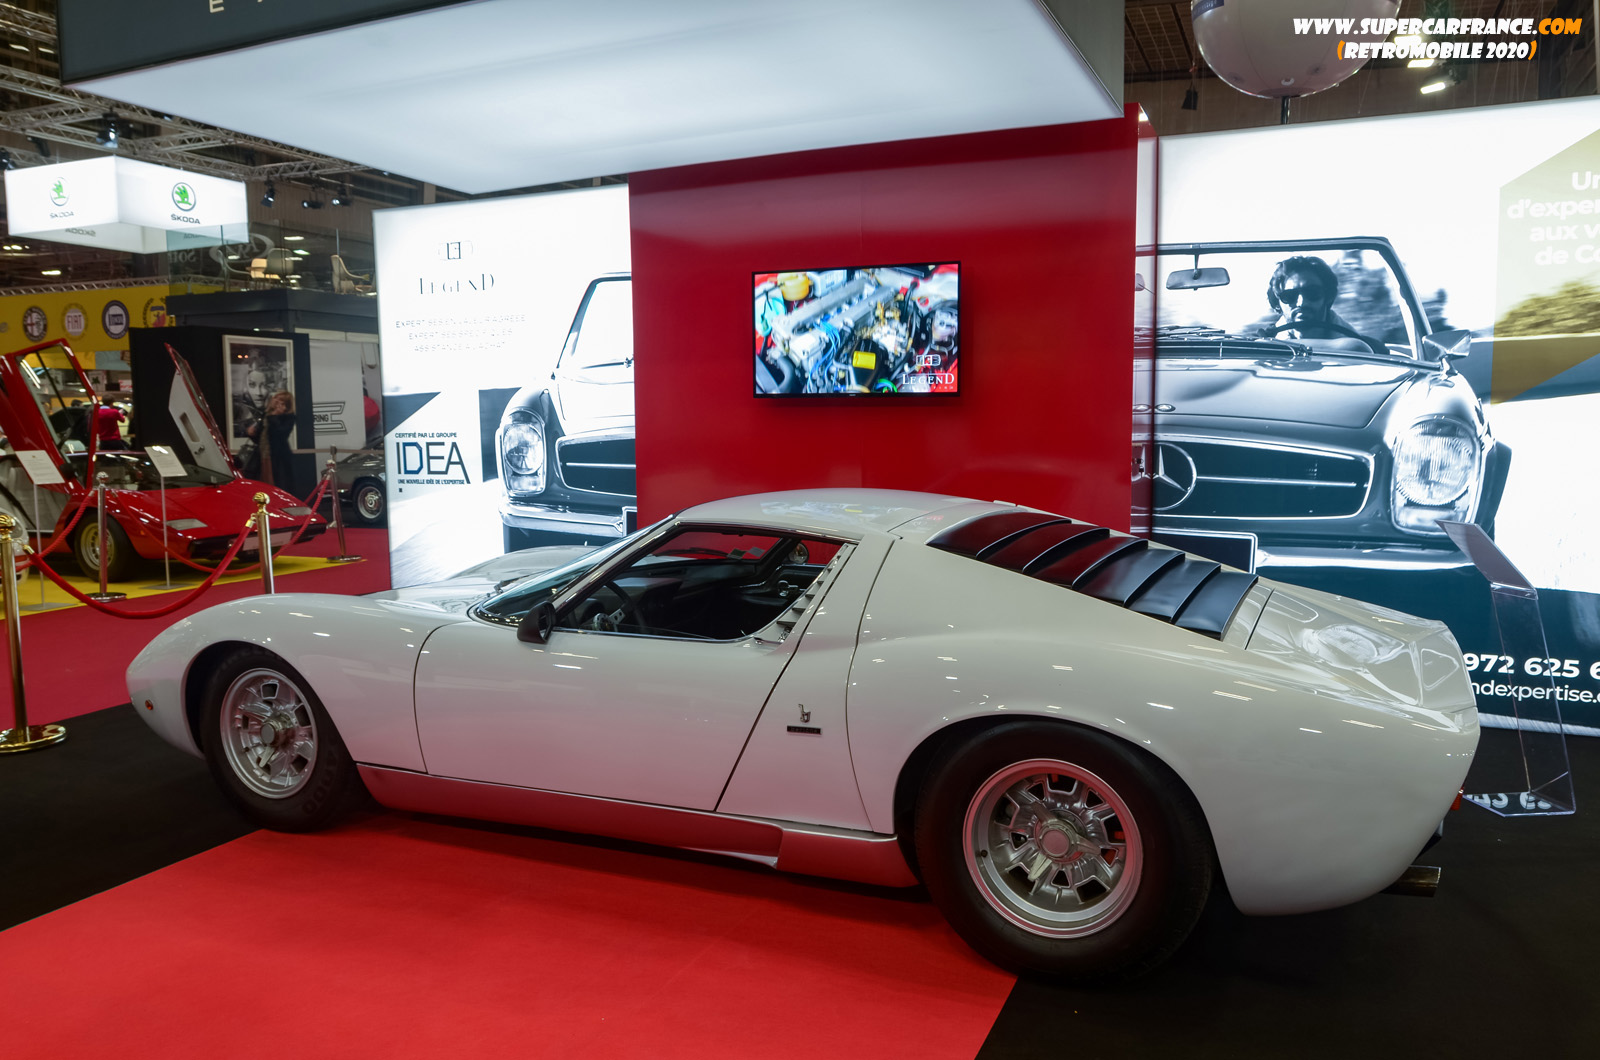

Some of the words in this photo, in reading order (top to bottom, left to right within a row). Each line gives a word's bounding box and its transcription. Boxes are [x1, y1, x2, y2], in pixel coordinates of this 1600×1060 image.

[1530, 225, 1579, 241] aux
[1535, 246, 1569, 265] de
[902, 373, 955, 385] LEGEND
[396, 441, 471, 484] IDEA
[1462, 653, 1515, 674] 972
[1524, 657, 1580, 678] 625
